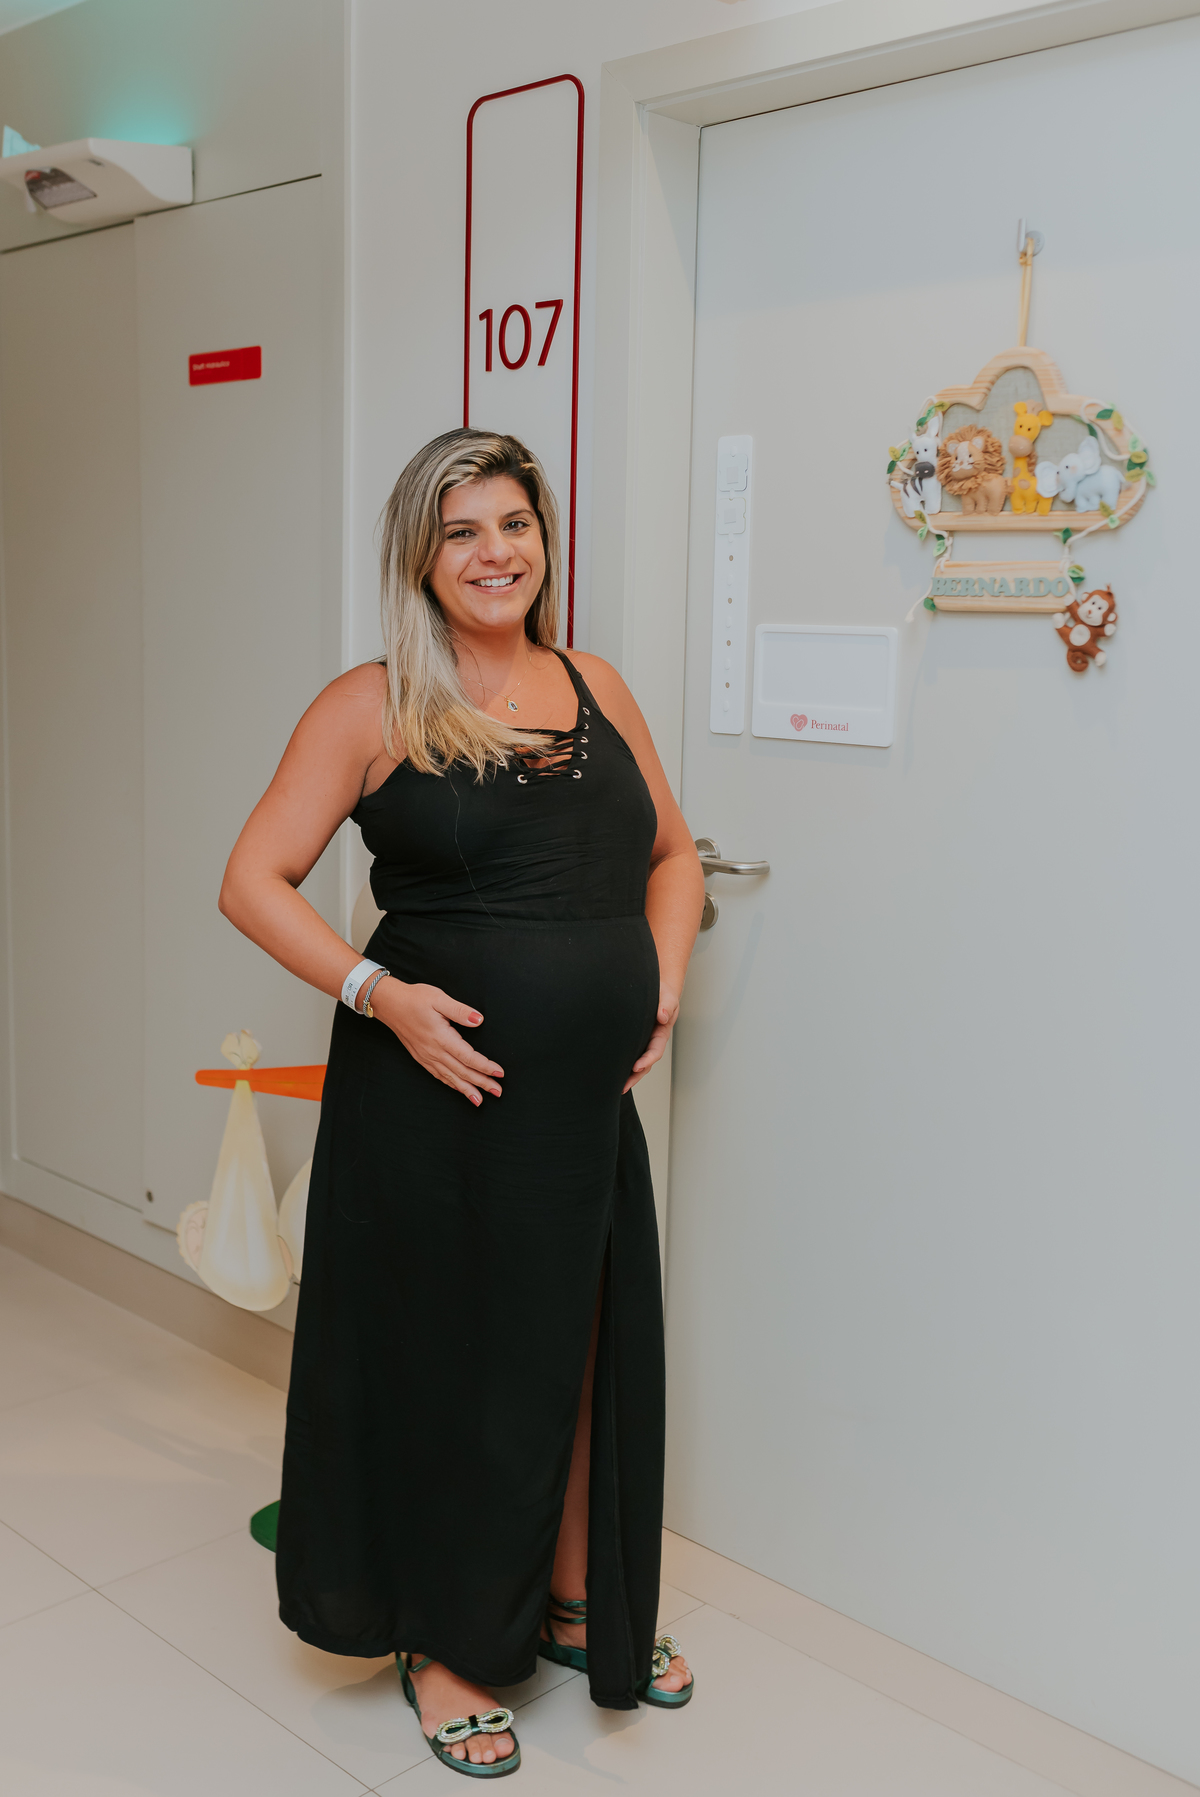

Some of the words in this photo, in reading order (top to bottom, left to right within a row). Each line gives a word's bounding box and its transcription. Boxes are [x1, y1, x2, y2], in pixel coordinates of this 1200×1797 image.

[479, 299, 563, 372] 107
[931, 577, 1070, 597] BERNARDO
[811, 719, 849, 731] Perinatal
